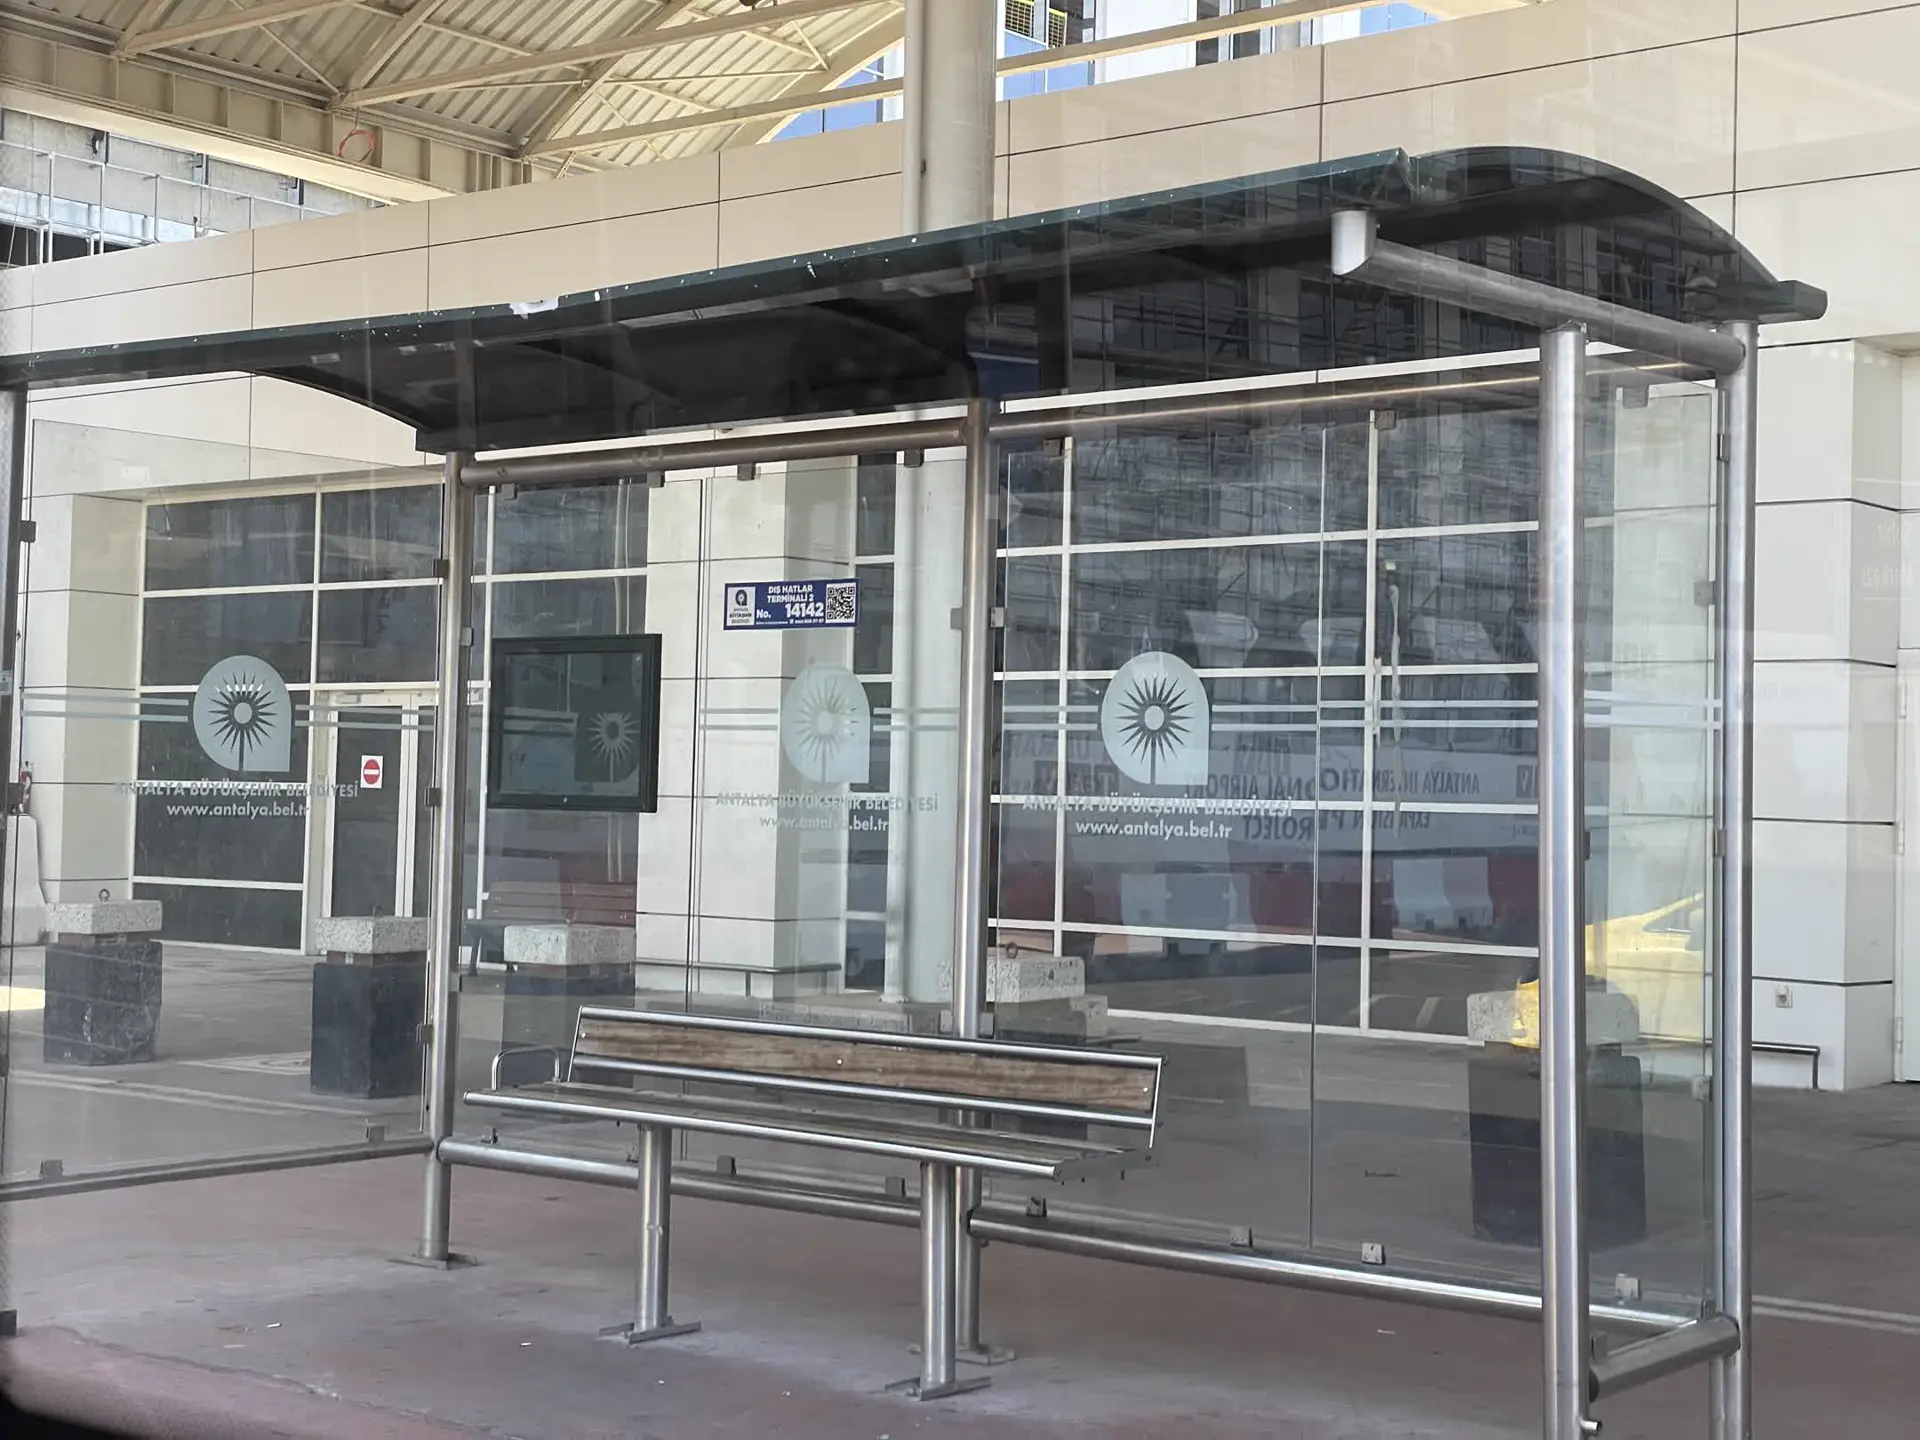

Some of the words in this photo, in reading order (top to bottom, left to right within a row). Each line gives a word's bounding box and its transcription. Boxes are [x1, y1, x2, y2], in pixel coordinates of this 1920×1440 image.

[768, 586, 780, 595] DIŞ
[782, 584, 813, 593] HATLAR
[809, 594, 815, 602] 2
[756, 609, 772, 618] No.
[785, 602, 825, 618] 14142
[190, 778, 282, 799] BÜYÜKŞEHİR
[167, 802, 309, 820] www.antalya.bel.tr
[1023, 795, 1094, 811] ANTALYA
[1099, 792, 1199, 817] BÜYÜKŞEHİR
[1204, 794, 1293, 817] BELEDİYESİ
[1076, 817, 1233, 840] www.antalya.bel.tr
